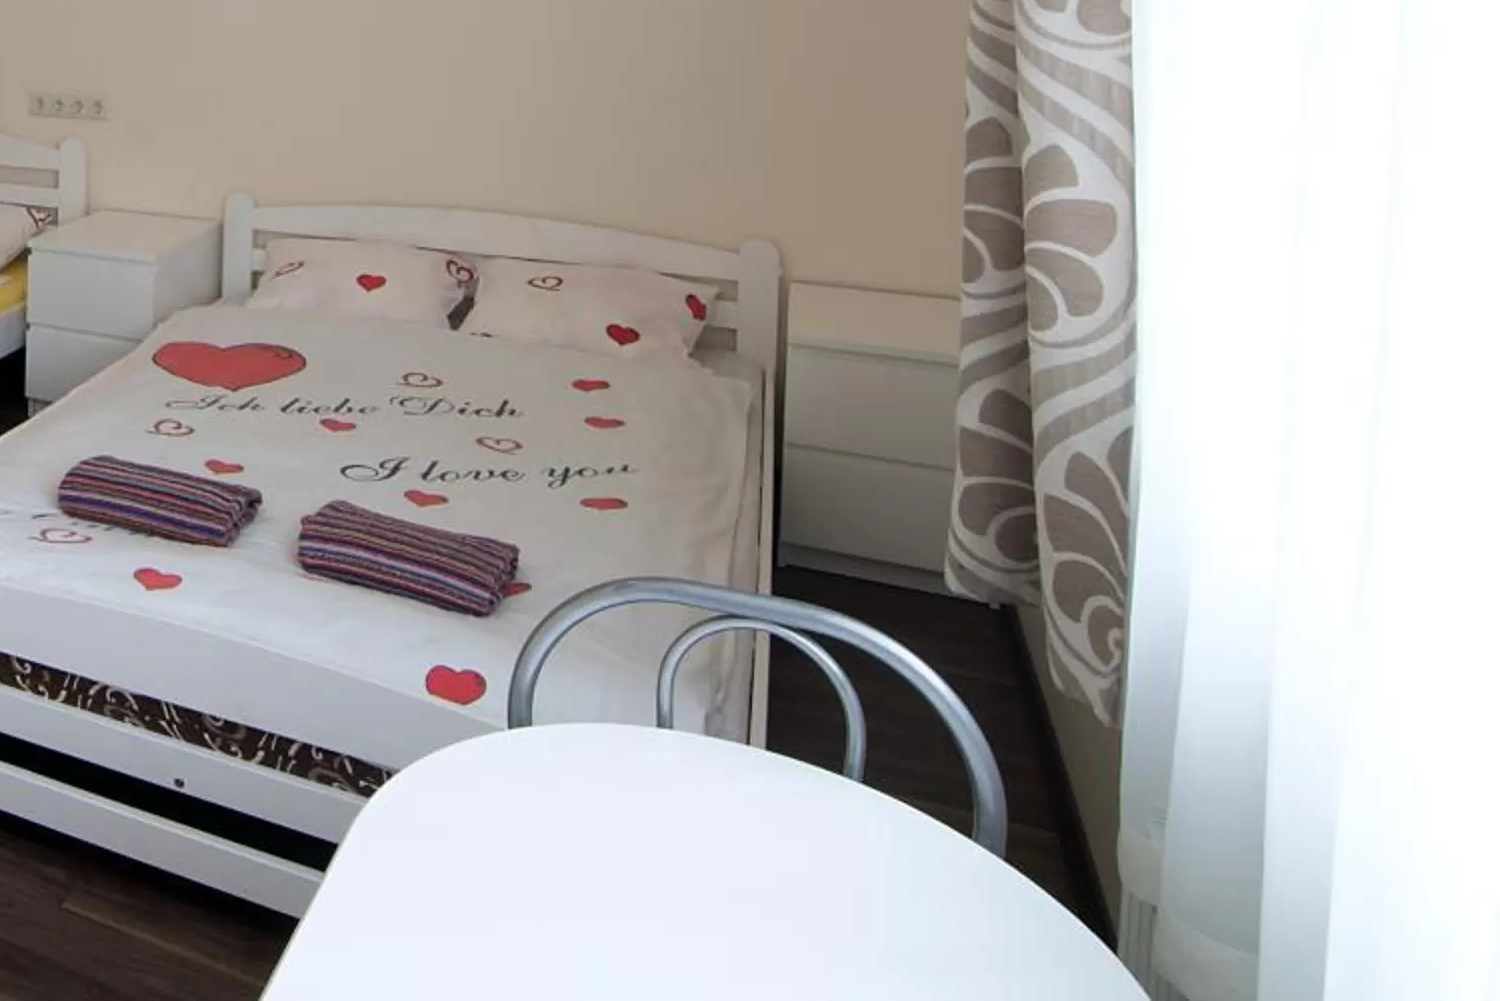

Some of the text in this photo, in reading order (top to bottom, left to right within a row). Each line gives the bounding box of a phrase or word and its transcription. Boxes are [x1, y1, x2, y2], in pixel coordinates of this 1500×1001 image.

[165, 393, 526, 419] Ich liebe Dich
[339, 456, 640, 490] I love you
